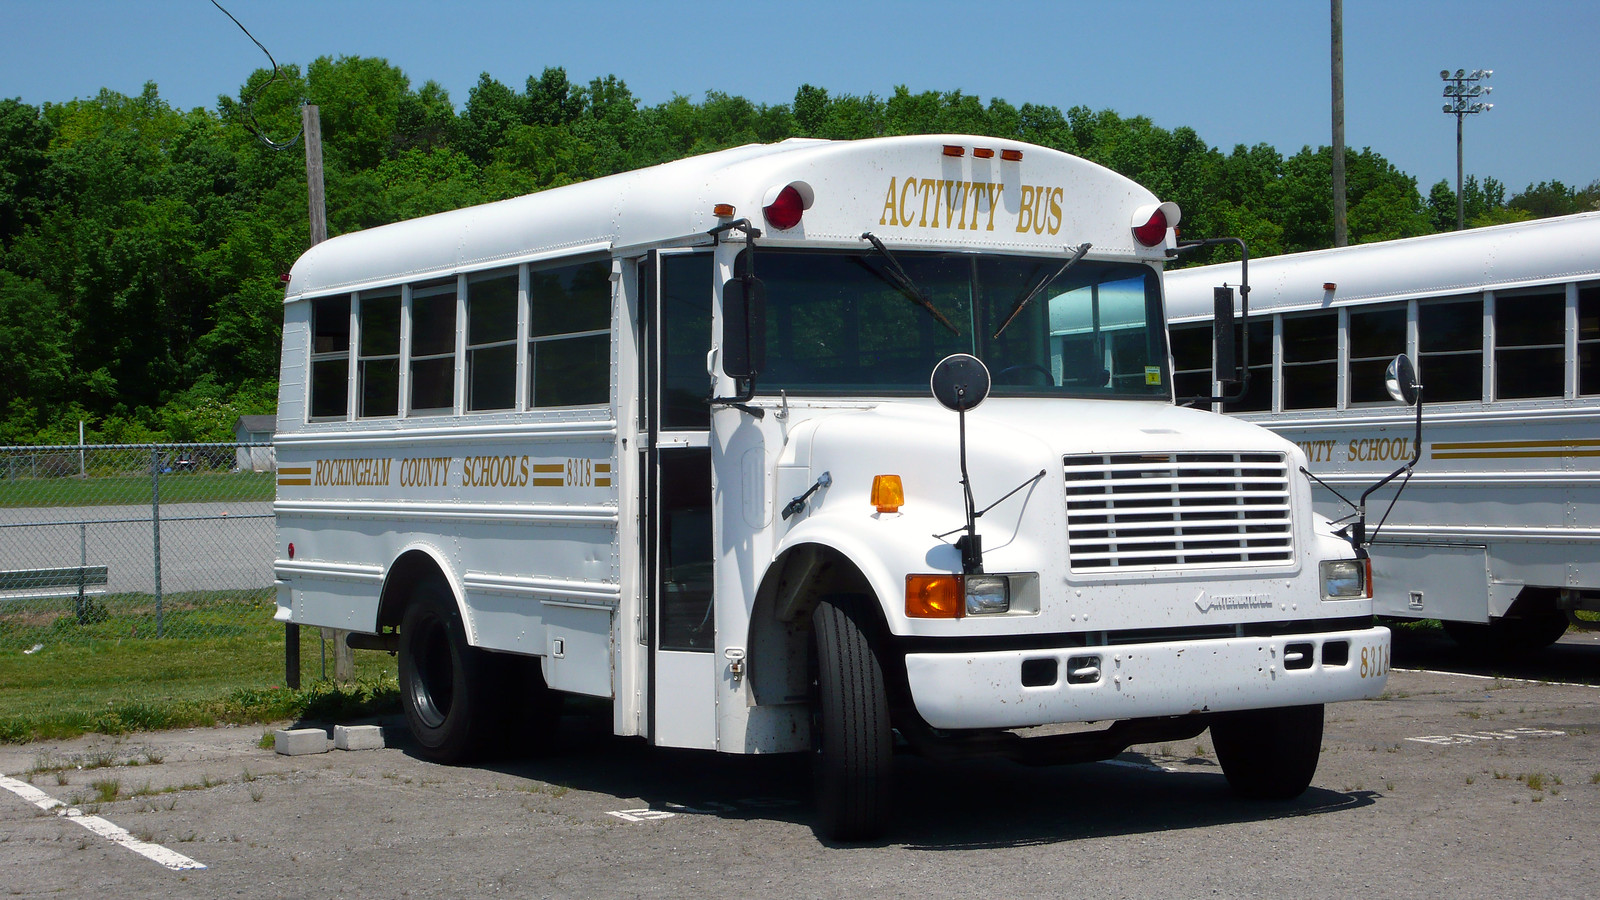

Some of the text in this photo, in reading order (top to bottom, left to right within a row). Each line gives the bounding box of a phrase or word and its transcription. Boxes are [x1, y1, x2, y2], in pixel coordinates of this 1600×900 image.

[879, 176, 1064, 235] ACTIVITY BUS
[1296, 440, 1336, 462] UNTY
[314, 455, 529, 488] ROCKINGHAM COUNTY SCHOOLS
[566, 458, 591, 487] 8318
[1361, 644, 1390, 678] 8318
